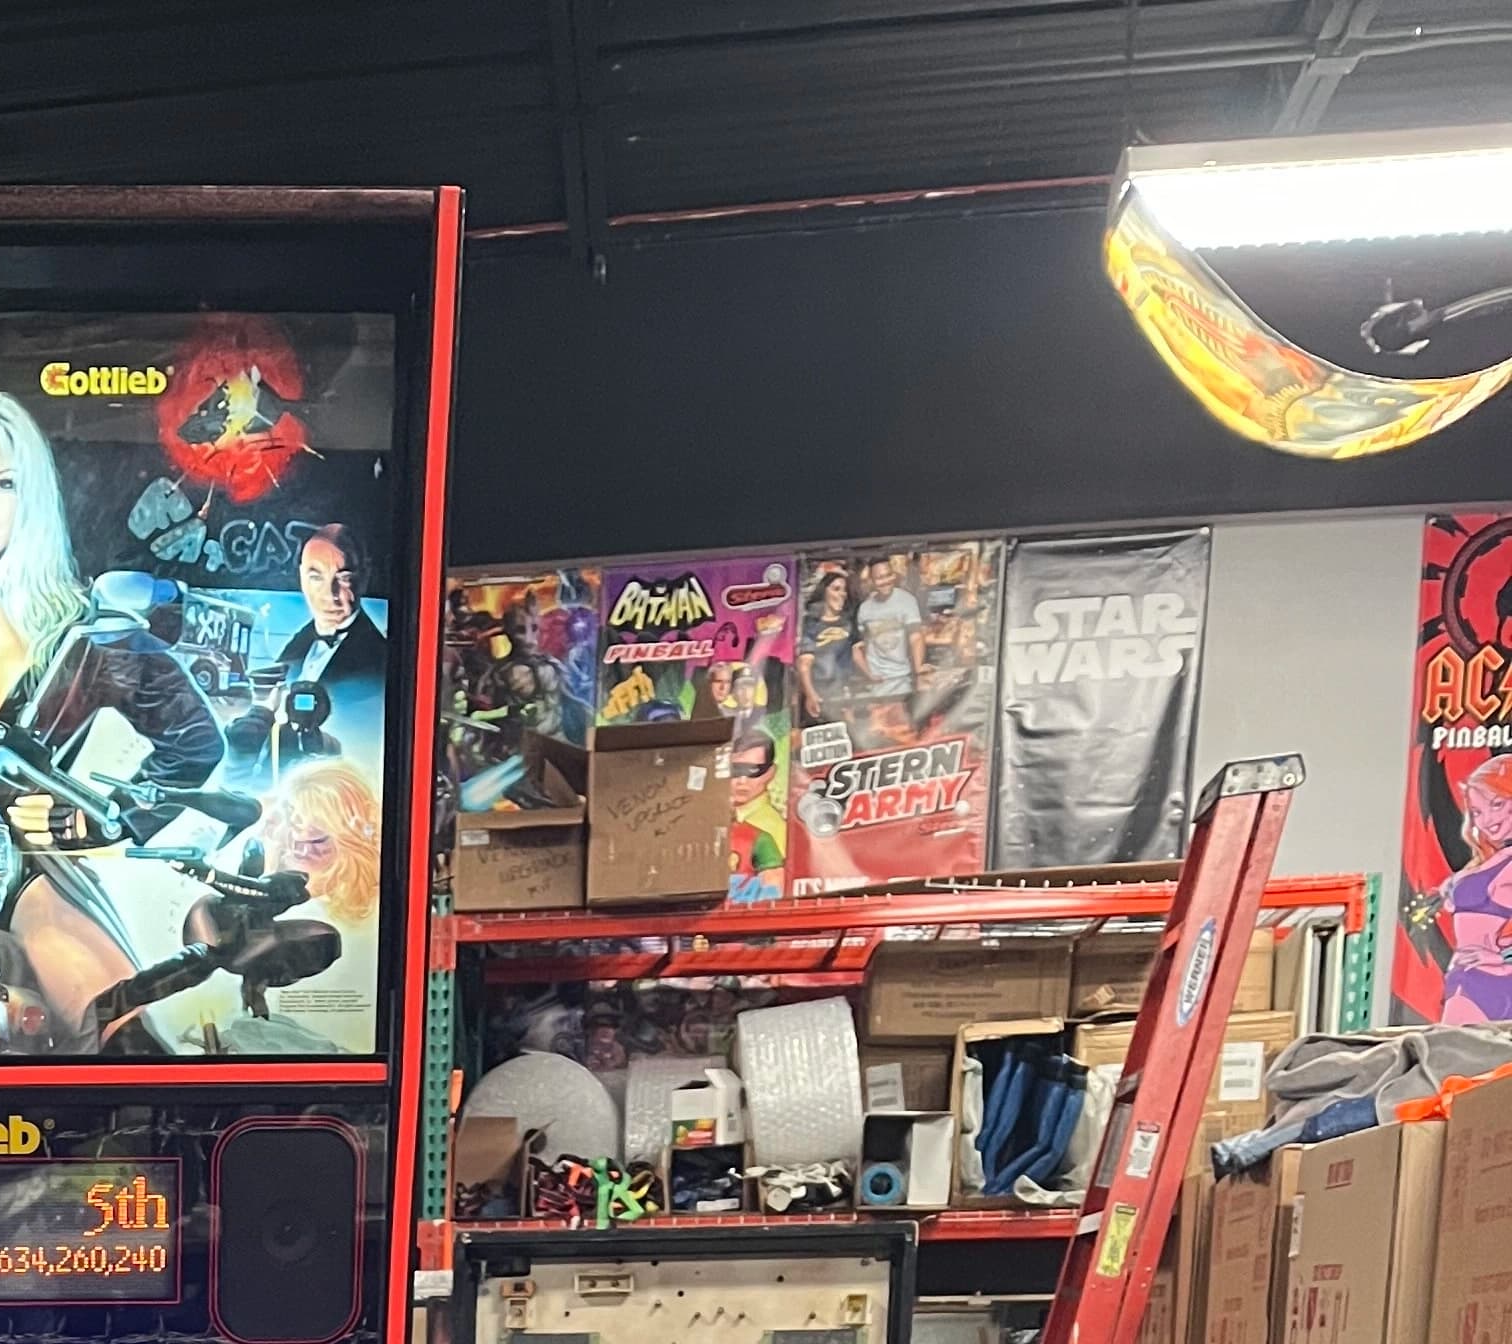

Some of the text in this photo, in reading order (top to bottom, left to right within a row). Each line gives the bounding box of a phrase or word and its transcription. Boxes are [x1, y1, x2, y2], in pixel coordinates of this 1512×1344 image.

[40, 362, 168, 396] Gottlieb
[608, 576, 714, 630] BATMAN
[1007, 592, 1199, 643] STAR
[603, 640, 715, 664] PINBALL
[1006, 634, 1197, 685] WARS
[825, 740, 965, 799] STERN
[839, 770, 973, 829] ARMY
[84, 1175, 170, 1237] 5th
